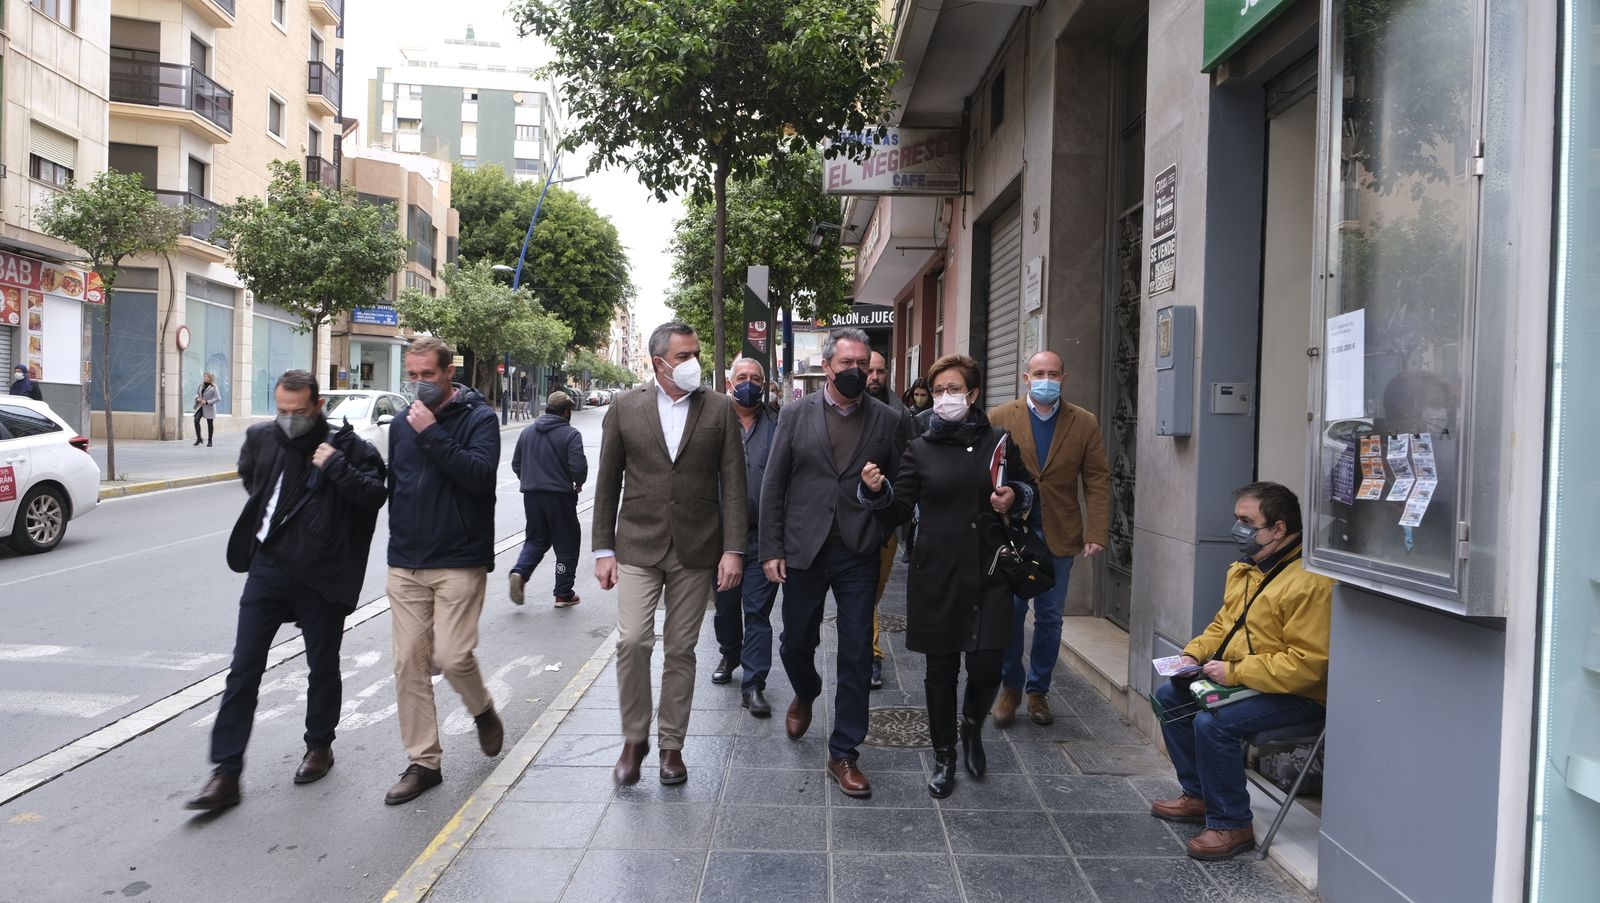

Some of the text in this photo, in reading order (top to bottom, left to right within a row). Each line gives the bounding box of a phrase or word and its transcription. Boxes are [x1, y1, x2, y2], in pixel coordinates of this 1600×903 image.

[828, 164, 852, 189] EL
[1150, 238, 1175, 263] SE VENDE
[757, 321, 764, 329] 18
[832, 312, 859, 326] SALON
[861, 315, 870, 324] DE
